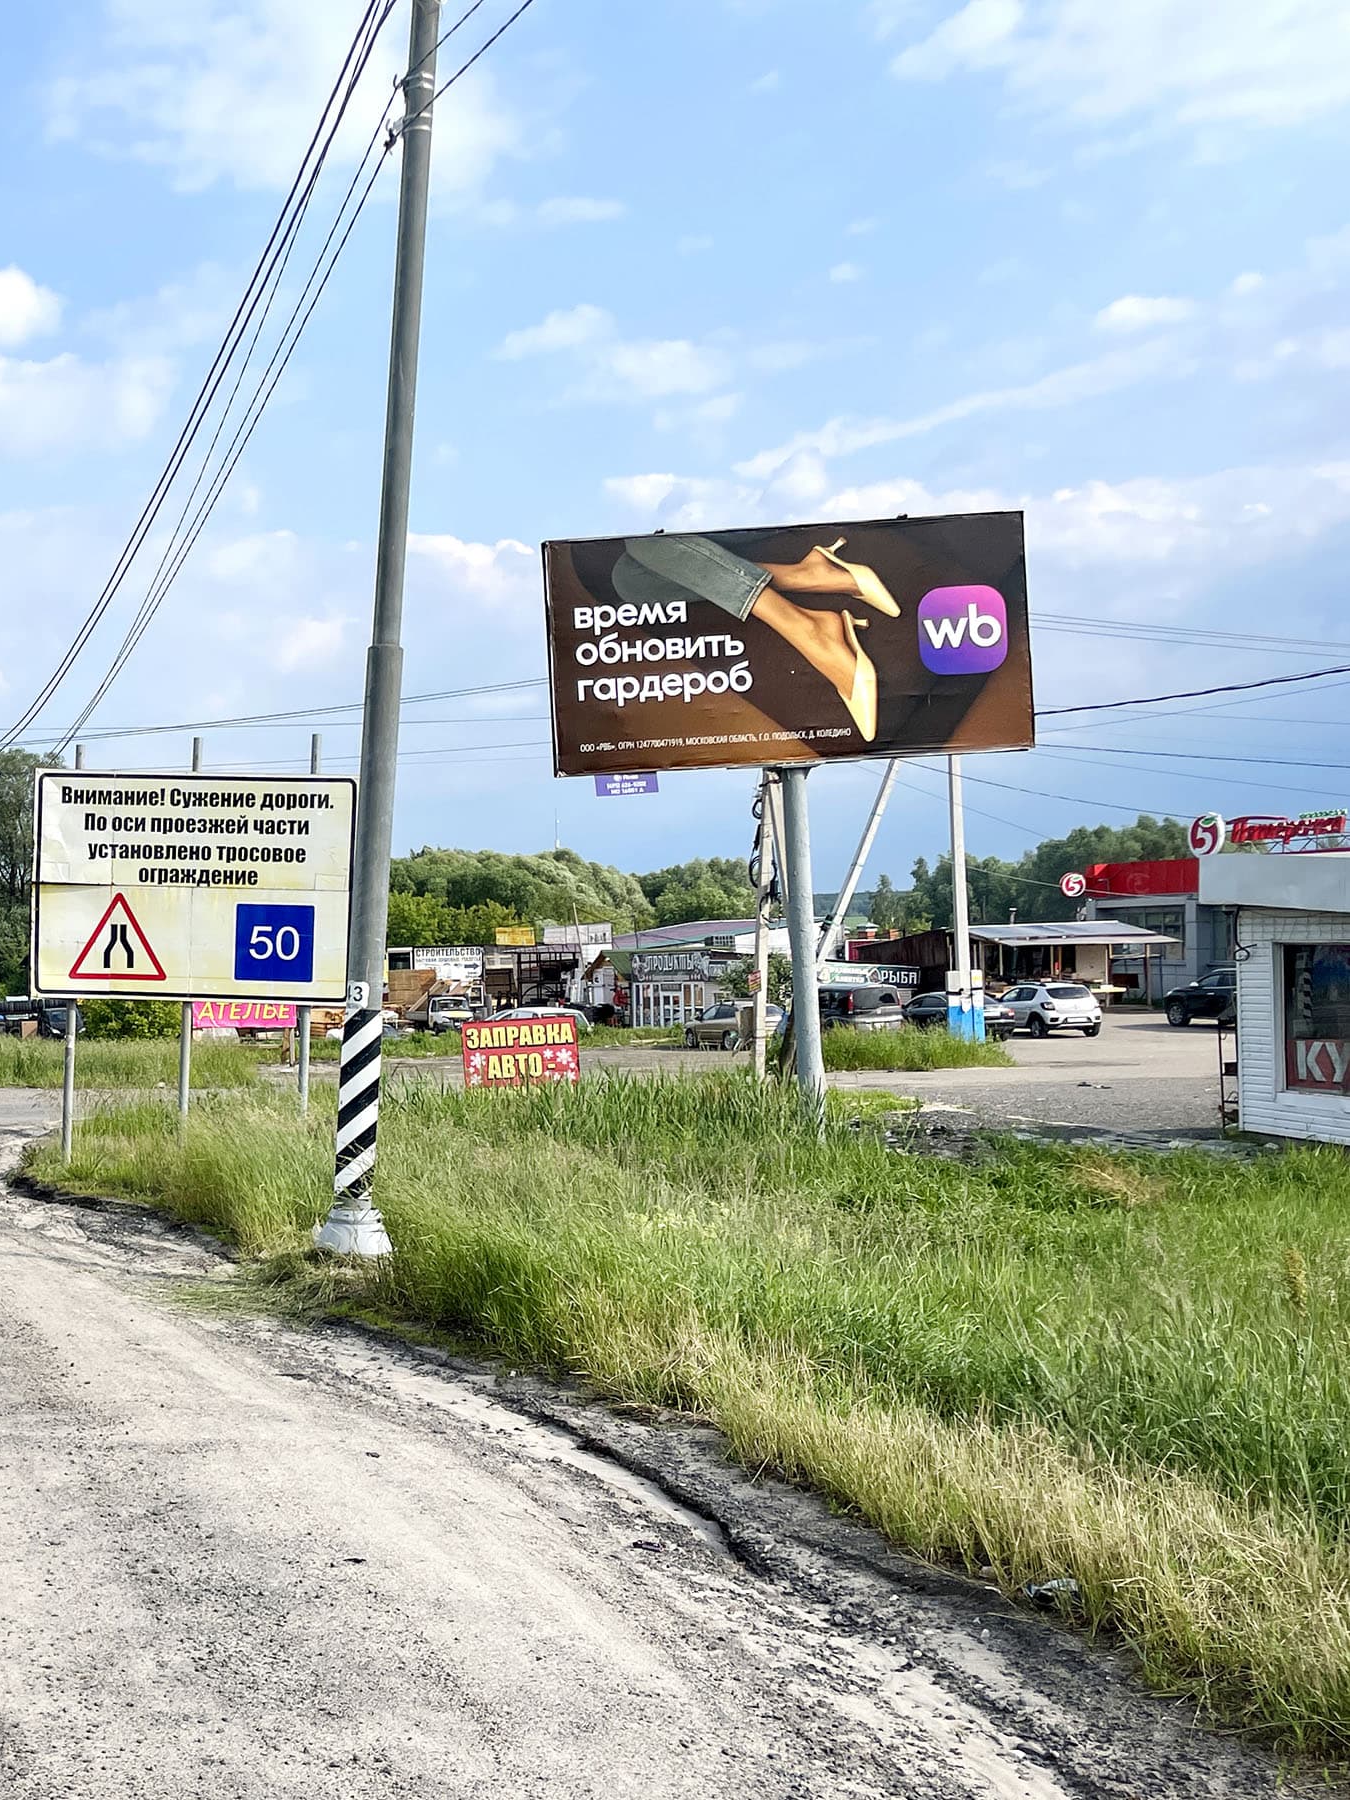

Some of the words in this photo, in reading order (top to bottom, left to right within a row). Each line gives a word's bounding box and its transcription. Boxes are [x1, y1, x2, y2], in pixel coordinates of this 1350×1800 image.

[574, 601, 687, 636] время
[923, 603, 1001, 650] wb
[576, 632, 745, 666] обновить
[577, 660, 753, 707] гардероб
[580, 743, 595, 752] ООО
[816, 727, 851, 738] КОЛЕДИНО
[61, 786, 165, 806] Внимание!
[170, 788, 256, 808] Сужение
[260, 793, 334, 811] дороги.
[84, 813, 107, 831] По
[112, 816, 146, 832] оси
[150, 815, 248, 834] проезжей
[253, 820, 309, 835] части
[88, 843, 211, 860] установлено
[216, 845, 306, 863] тросовое
[138, 867, 258, 887] ограждение
[249, 925, 300, 961] 50
[416, 948, 481, 957] СТРОИТЕЛЬСТВО
[644, 955, 694, 971] ПРОДУКТЫ
[881, 969, 917, 984] РЫБА
[198, 1002, 291, 1020] АТЕЛЬЕ
[466, 1022, 574, 1050] ЗАПРАВКА
[488, 1052, 543, 1080] АВТО
